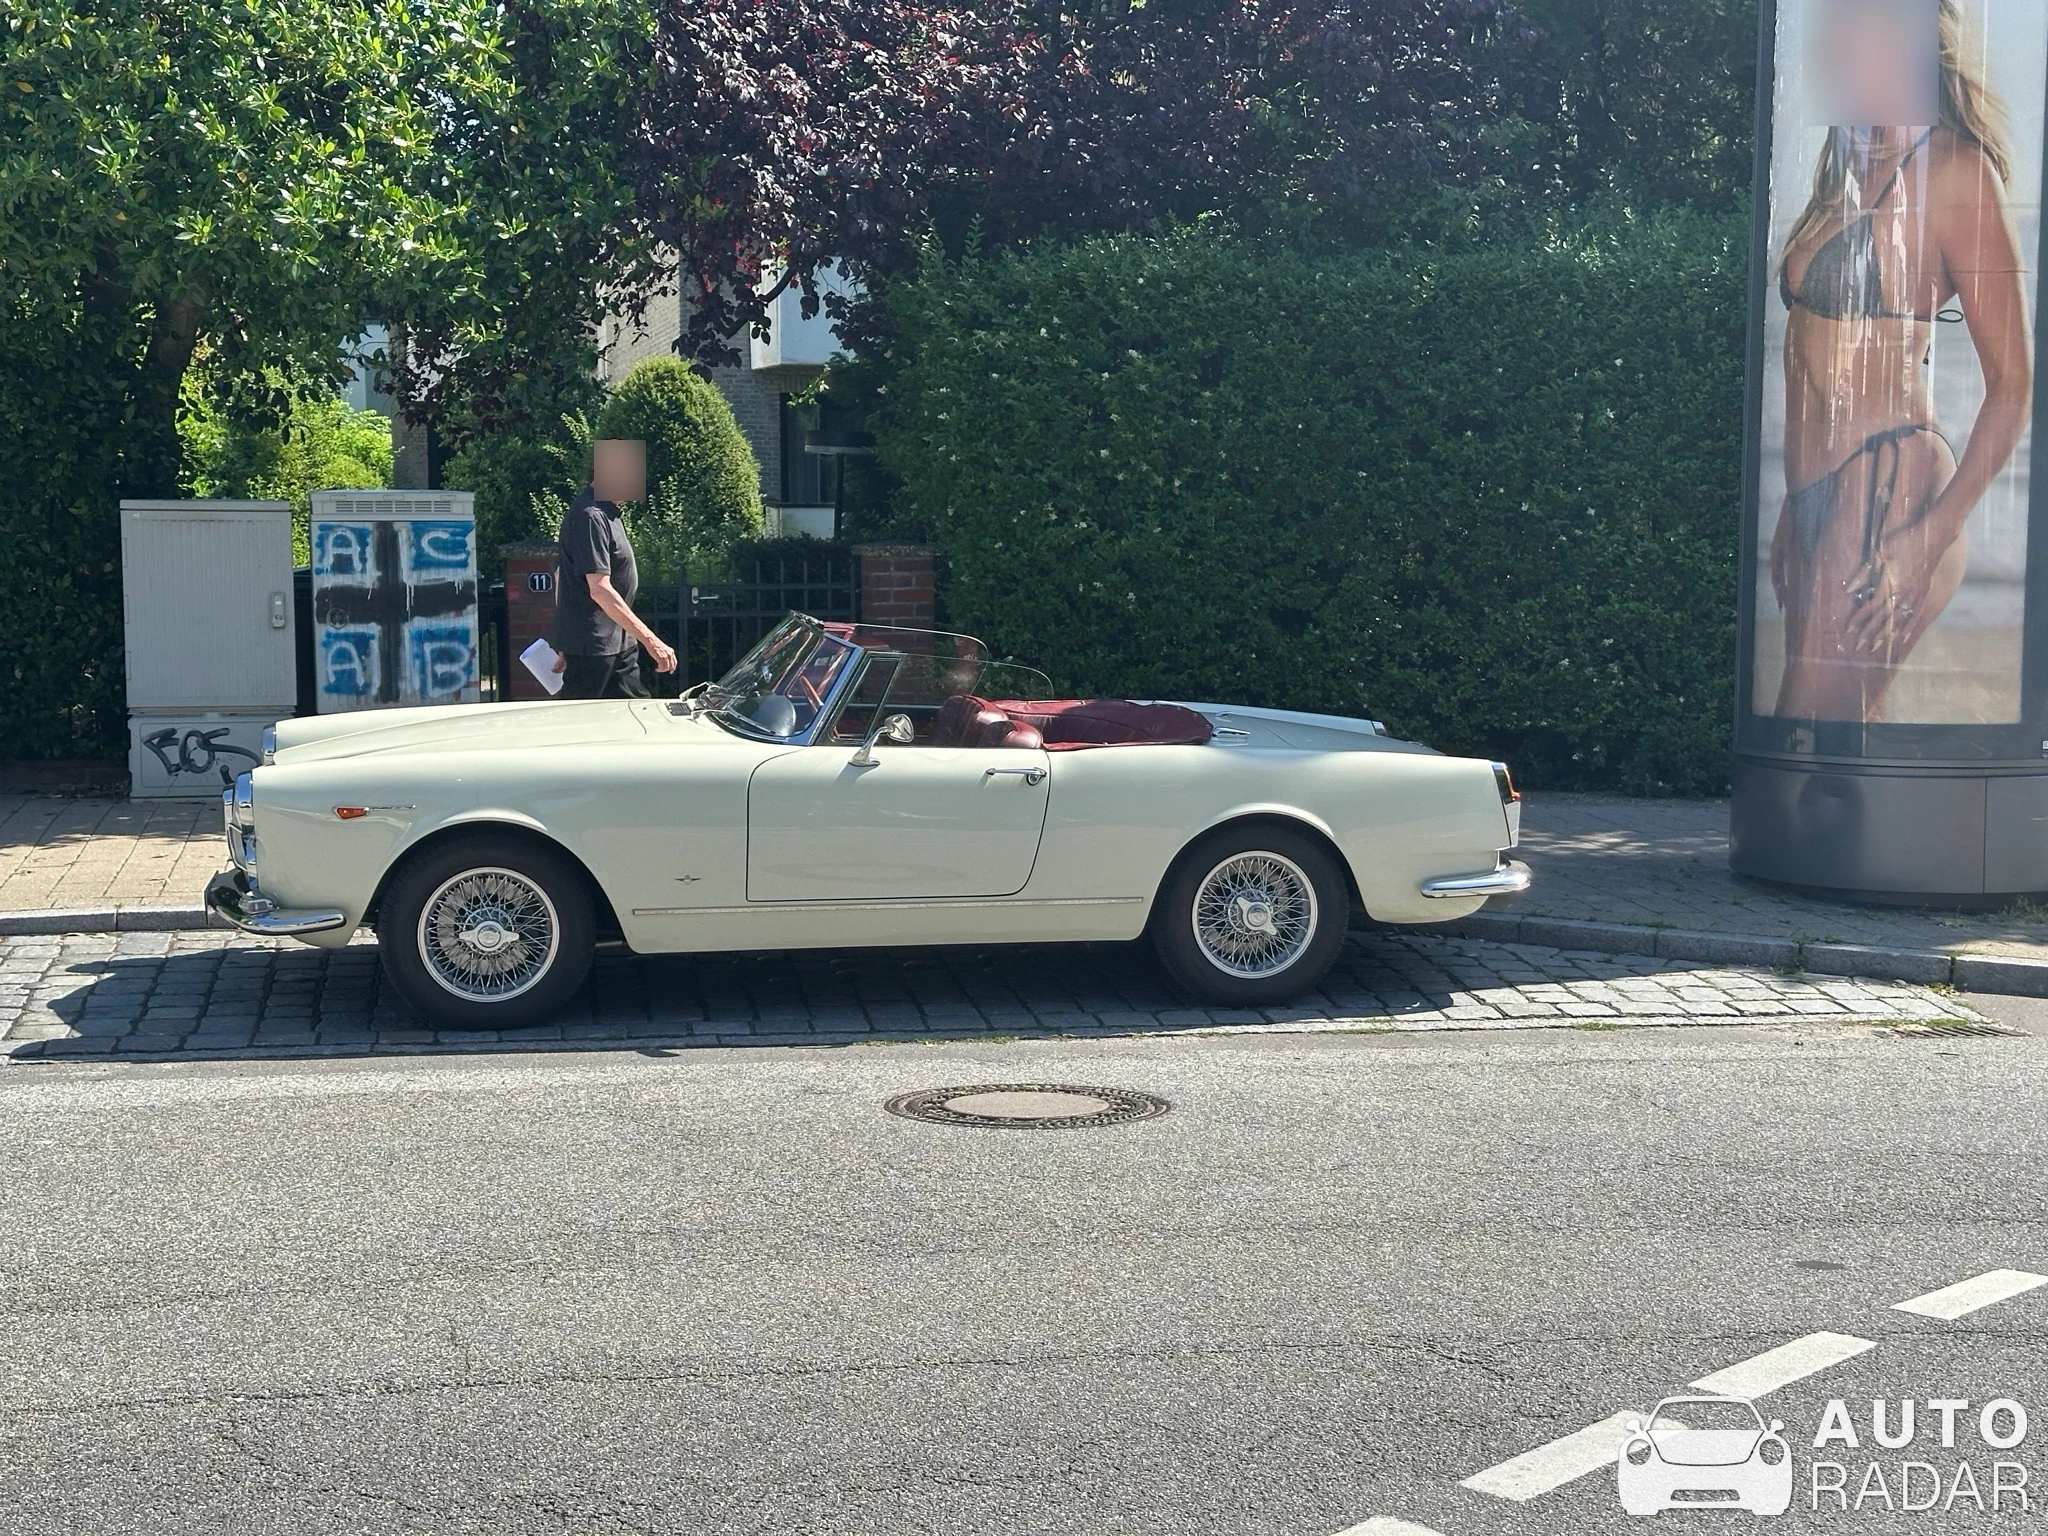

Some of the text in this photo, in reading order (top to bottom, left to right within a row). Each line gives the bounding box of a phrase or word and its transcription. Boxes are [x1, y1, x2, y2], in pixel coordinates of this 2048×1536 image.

[323, 529, 468, 573] A C
[533, 574, 546, 590] 11
[327, 640, 470, 698] A B
